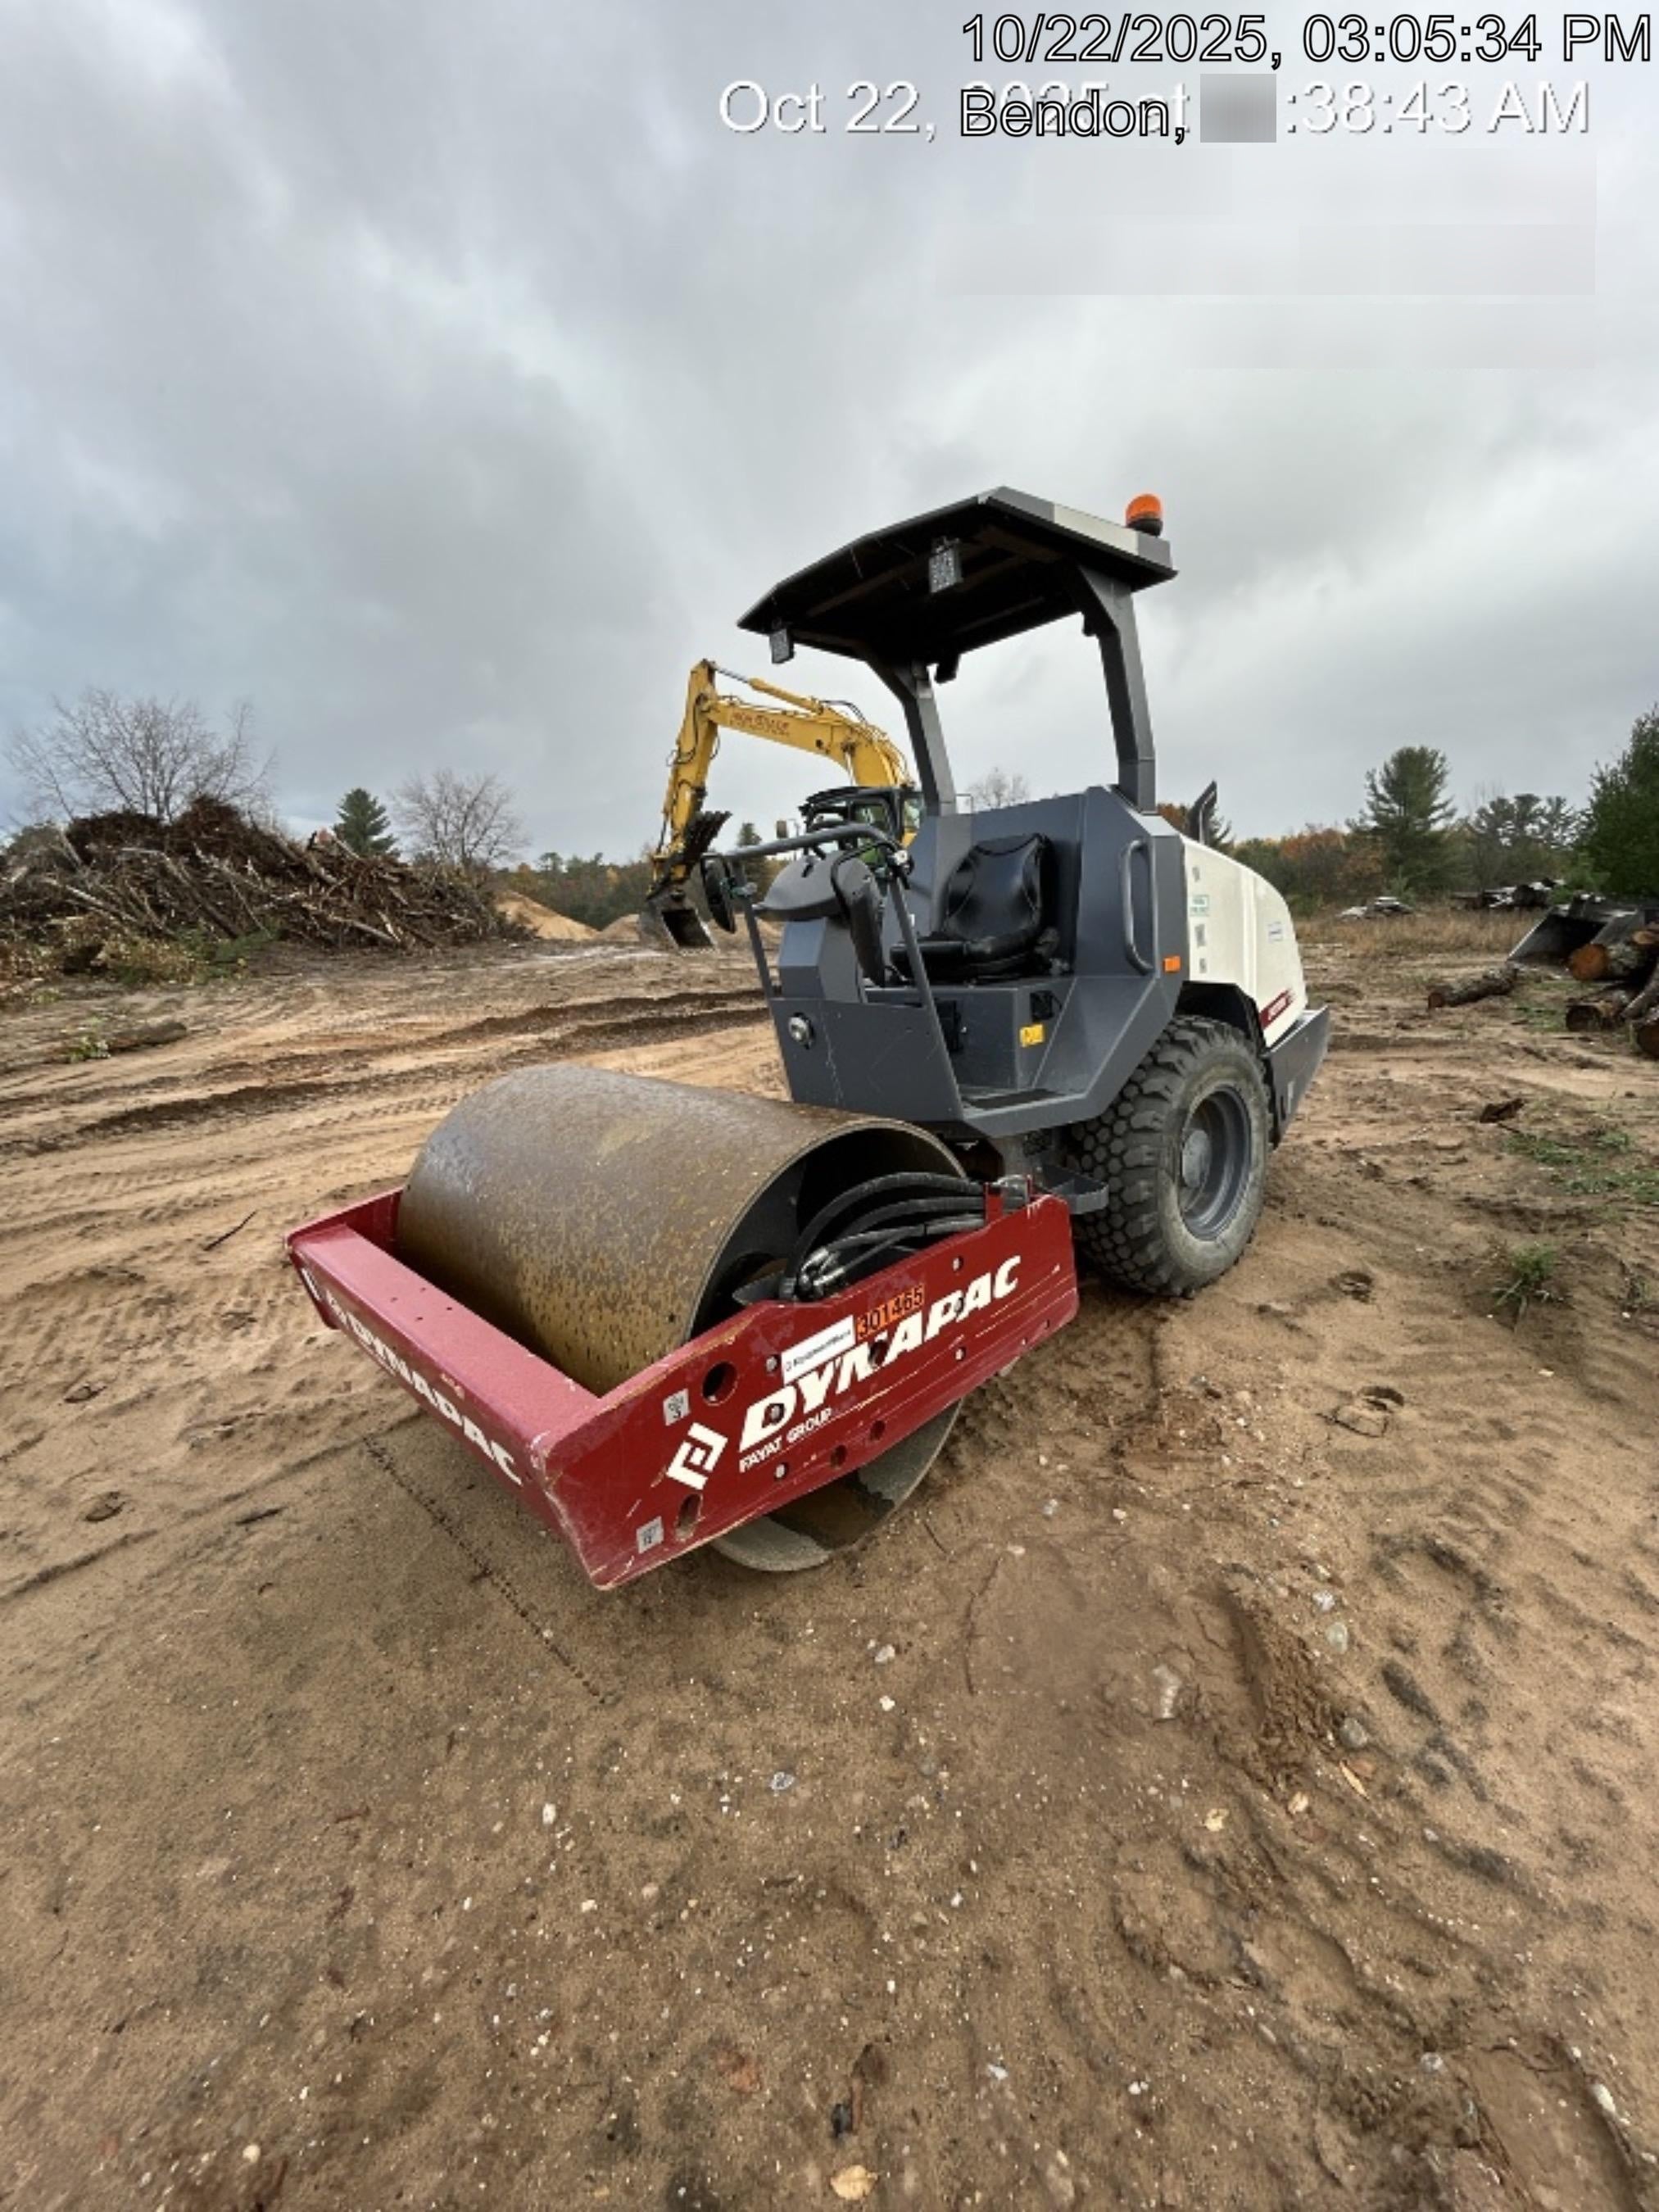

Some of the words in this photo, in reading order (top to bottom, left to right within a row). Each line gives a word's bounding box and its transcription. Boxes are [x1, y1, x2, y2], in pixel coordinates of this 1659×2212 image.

[739, 1255, 1021, 1453] DYNAPAC
[739, 1435, 782, 1472] FAYAT
[786, 1407, 832, 1443] GROUP
